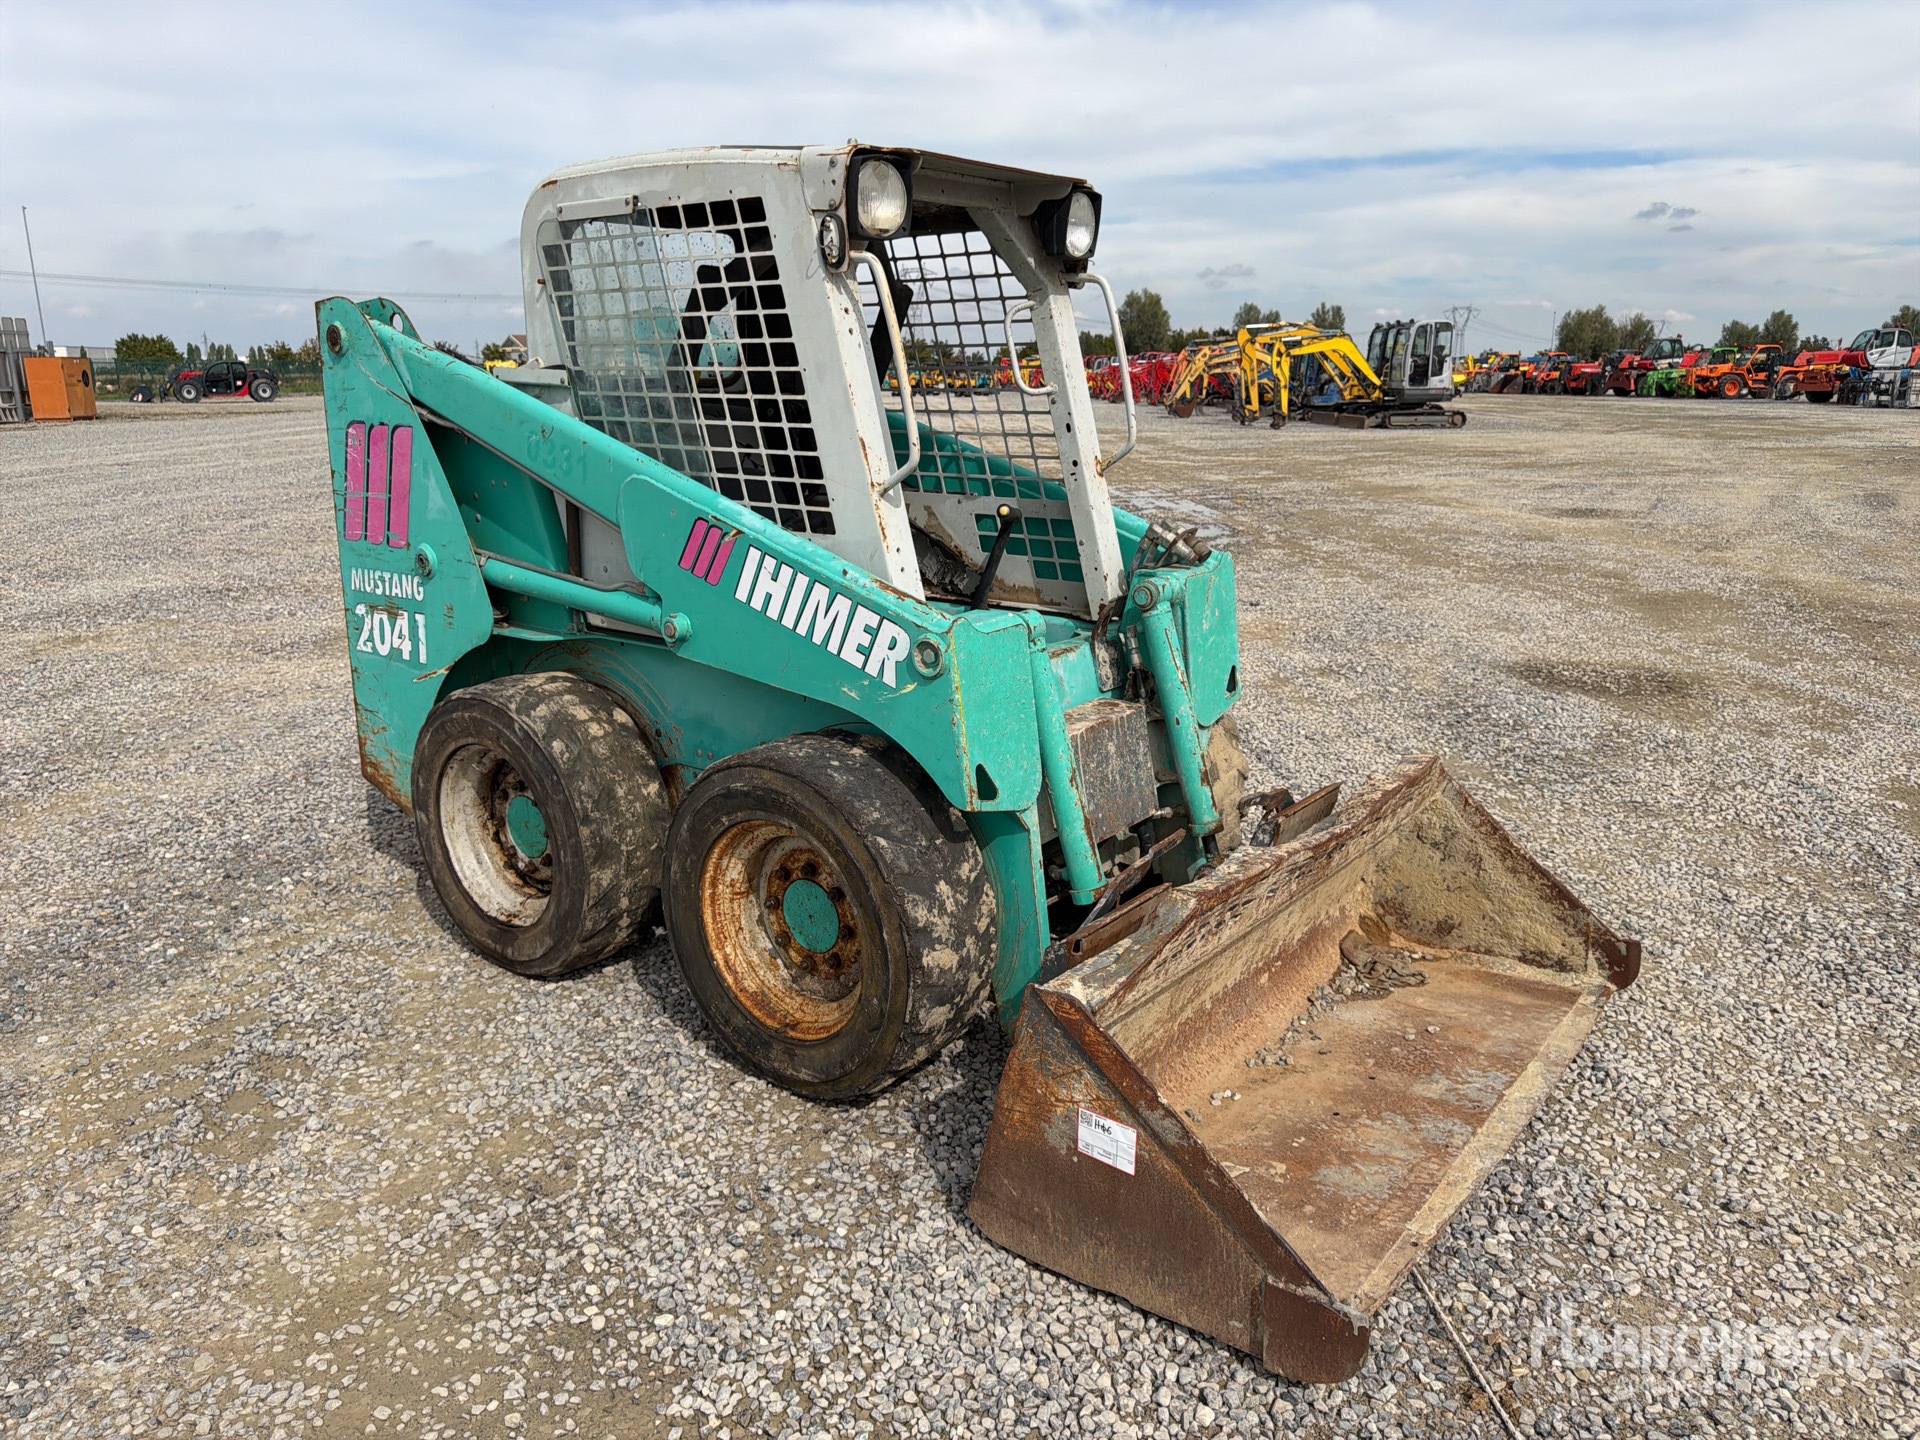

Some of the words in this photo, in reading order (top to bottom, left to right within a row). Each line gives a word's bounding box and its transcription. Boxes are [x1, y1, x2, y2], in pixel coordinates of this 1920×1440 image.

[351, 567, 424, 601] MUSTANG
[355, 603, 427, 664] 2041
[734, 544, 911, 689] IHIMER
